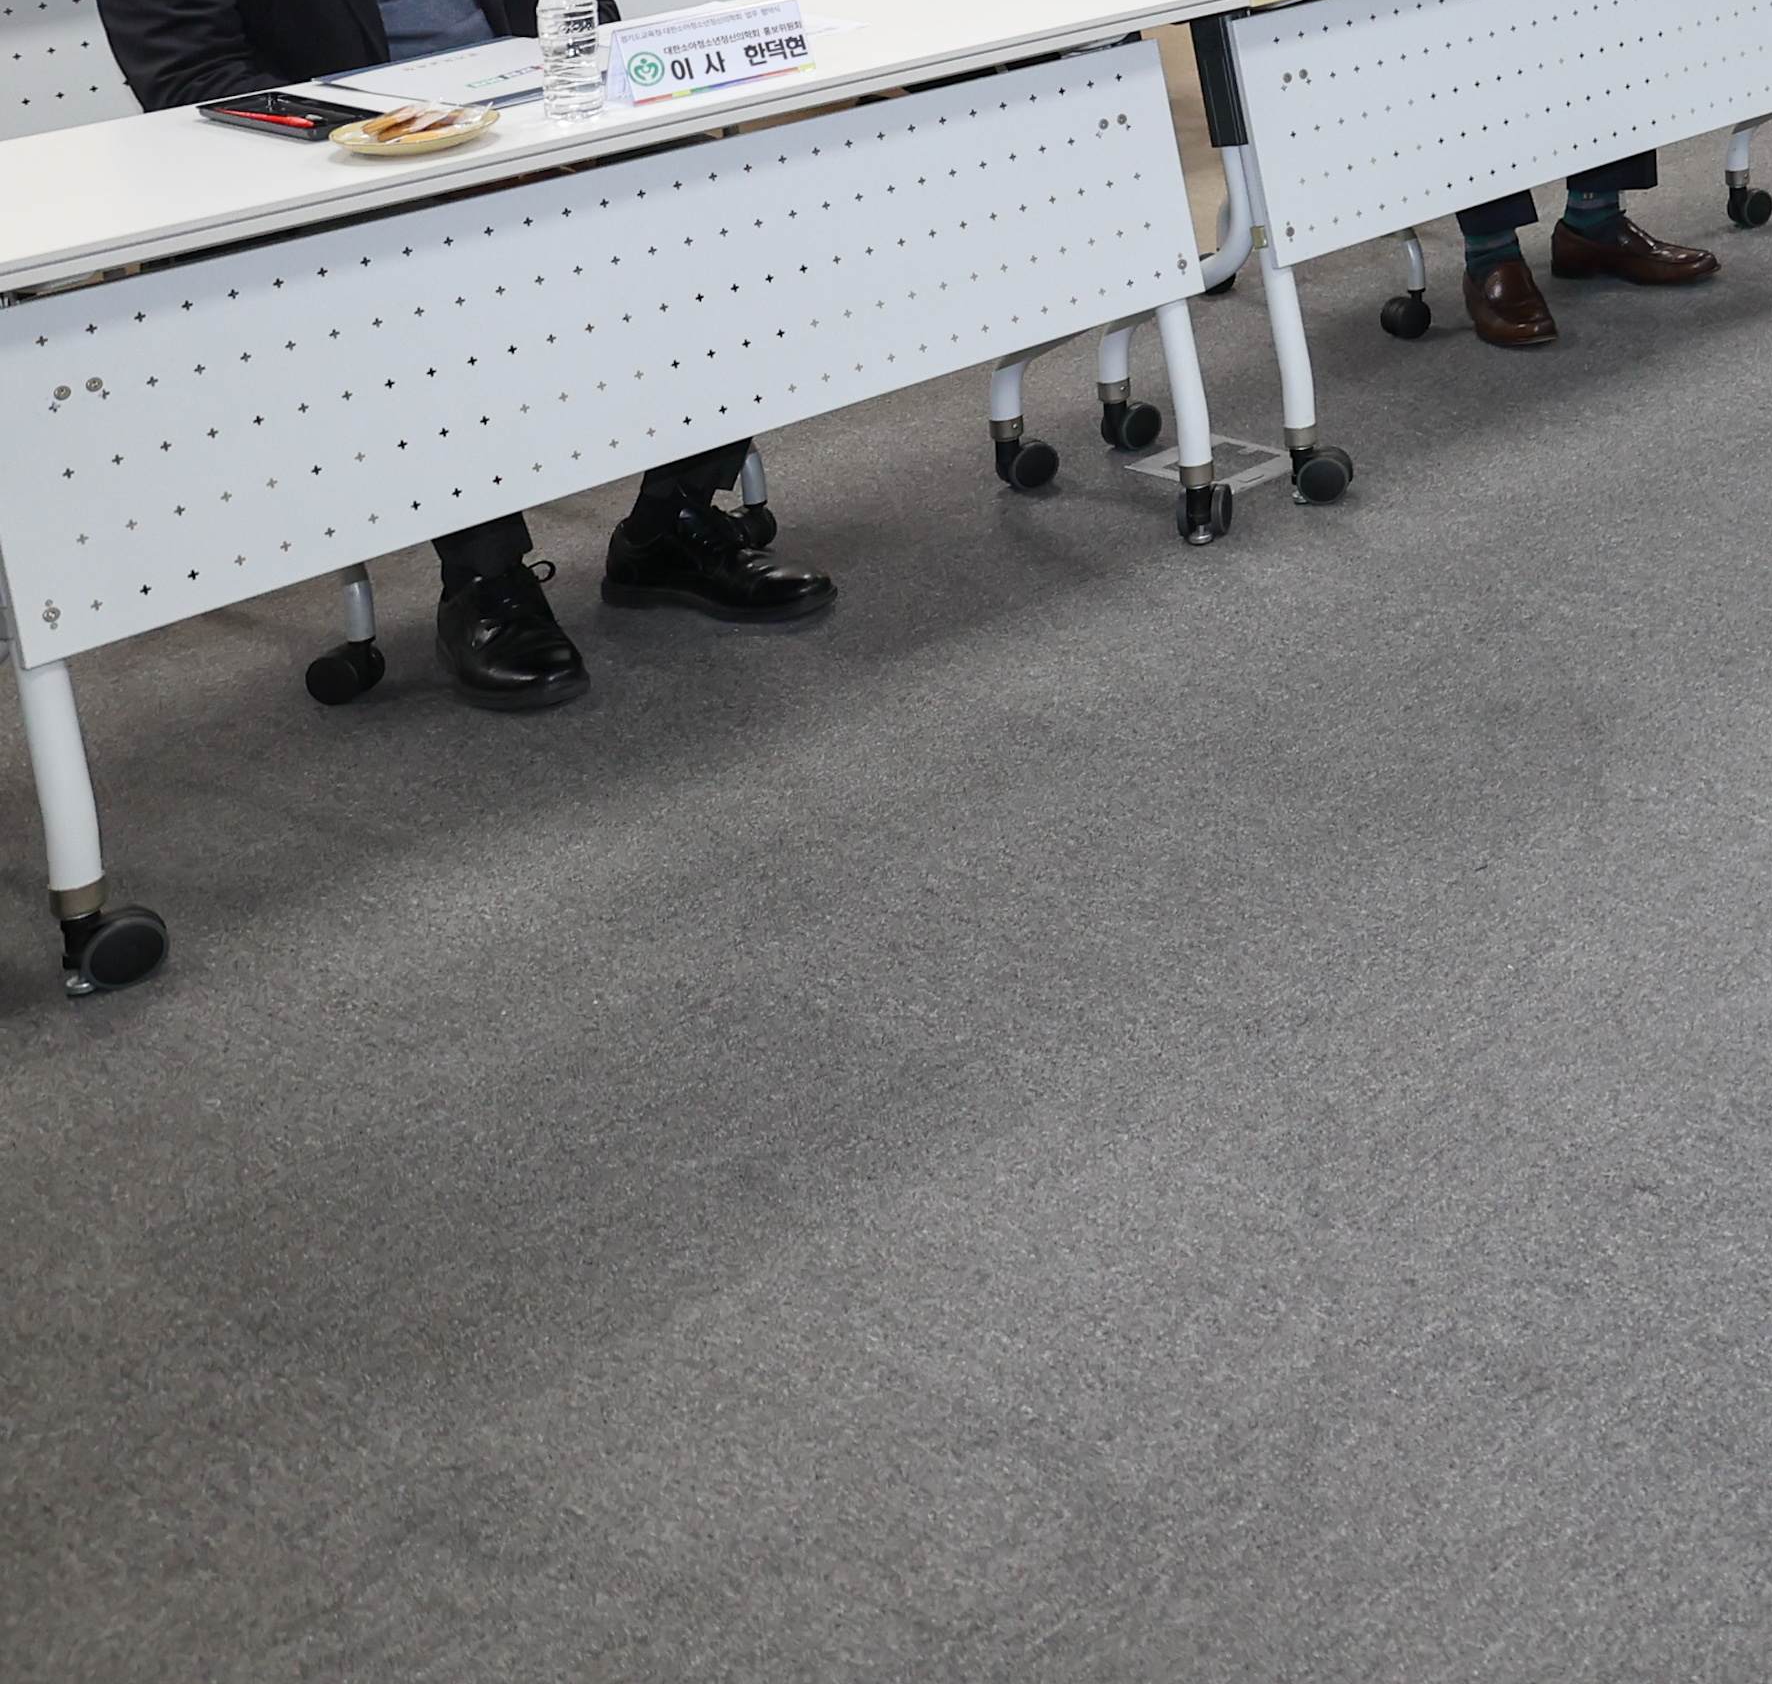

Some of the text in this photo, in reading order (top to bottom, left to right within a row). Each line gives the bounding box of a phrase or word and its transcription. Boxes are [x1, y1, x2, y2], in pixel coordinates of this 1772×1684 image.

[663, 20, 804, 56] 대한소아청소년정신의학회 홍보위원회
[671, 34, 809, 80] 이 사 한덕현
